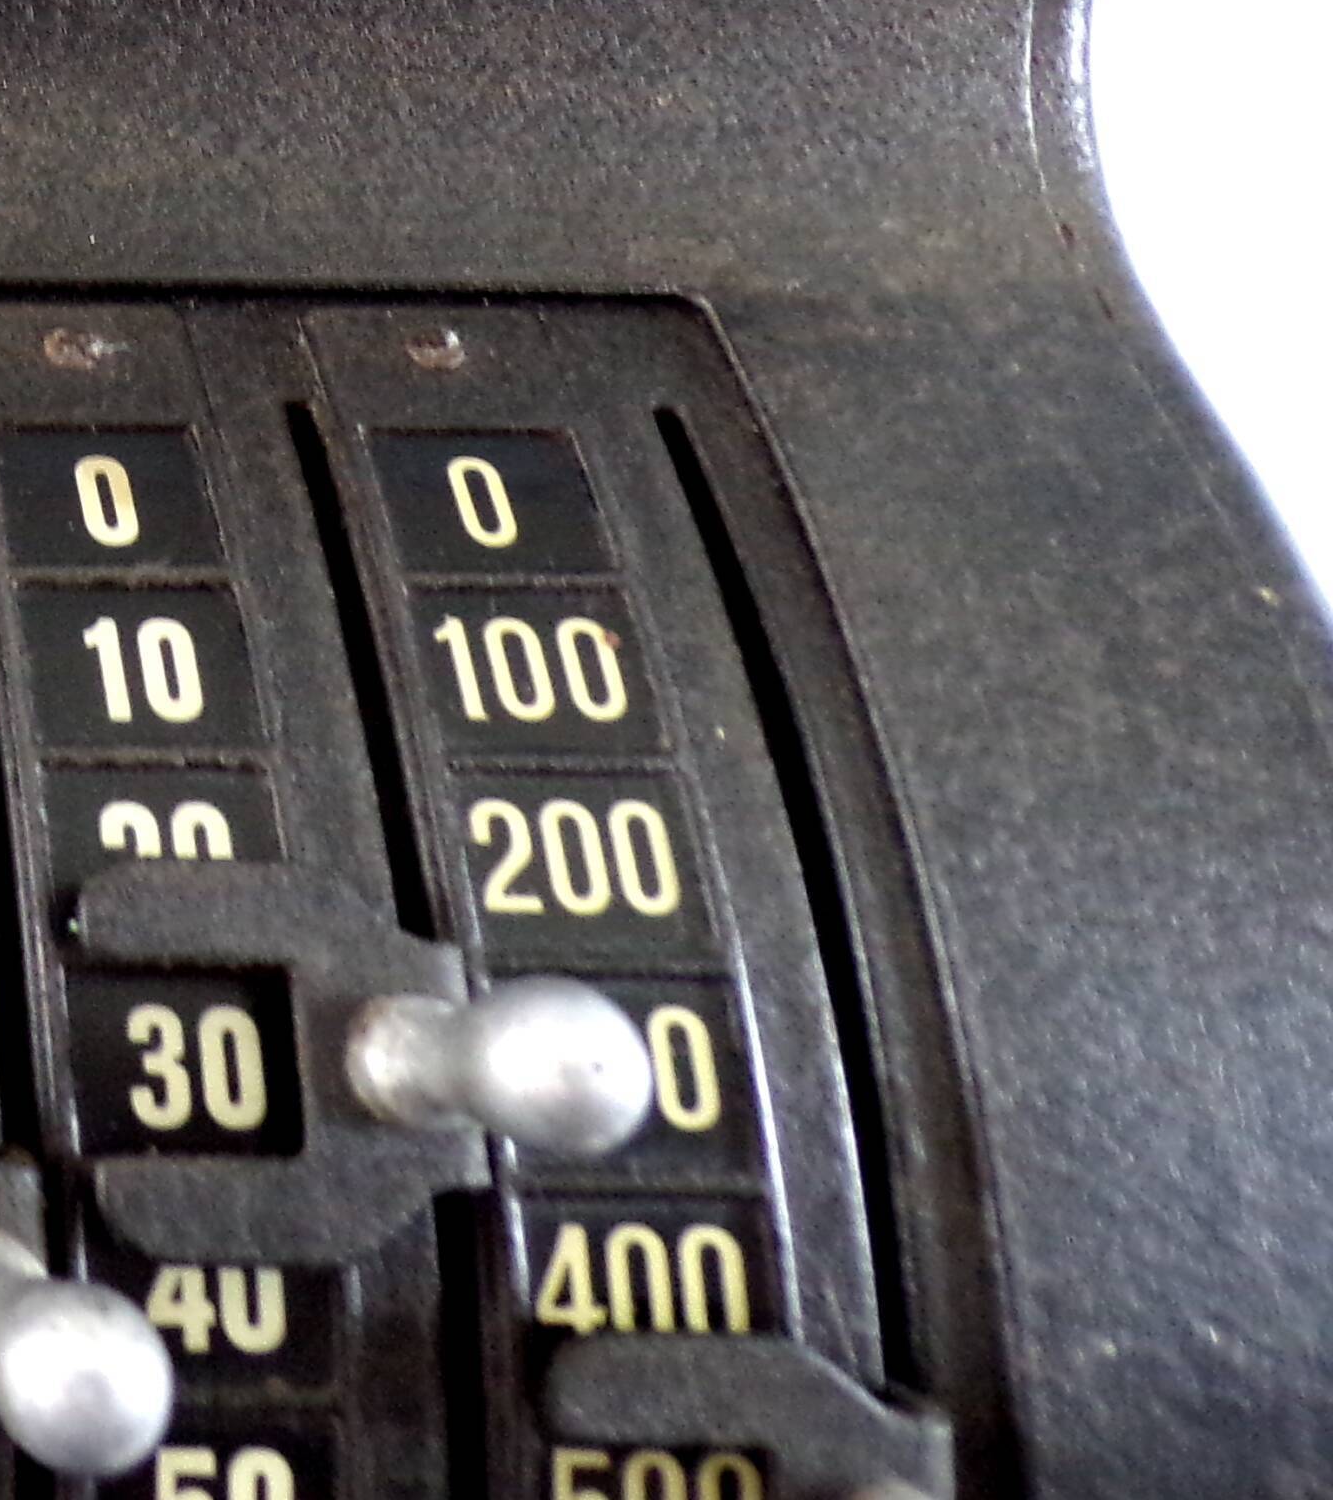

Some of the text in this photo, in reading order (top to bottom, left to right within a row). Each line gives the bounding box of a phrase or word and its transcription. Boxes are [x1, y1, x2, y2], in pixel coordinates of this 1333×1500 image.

[73, 455, 141, 547] 0
[446, 455, 518, 548] 0
[82, 616, 205, 723] 10
[434, 616, 628, 723] 100
[469, 798, 681, 917] 200
[126, 1002, 268, 1132] 30
[534, 1222, 751, 1334] 400
